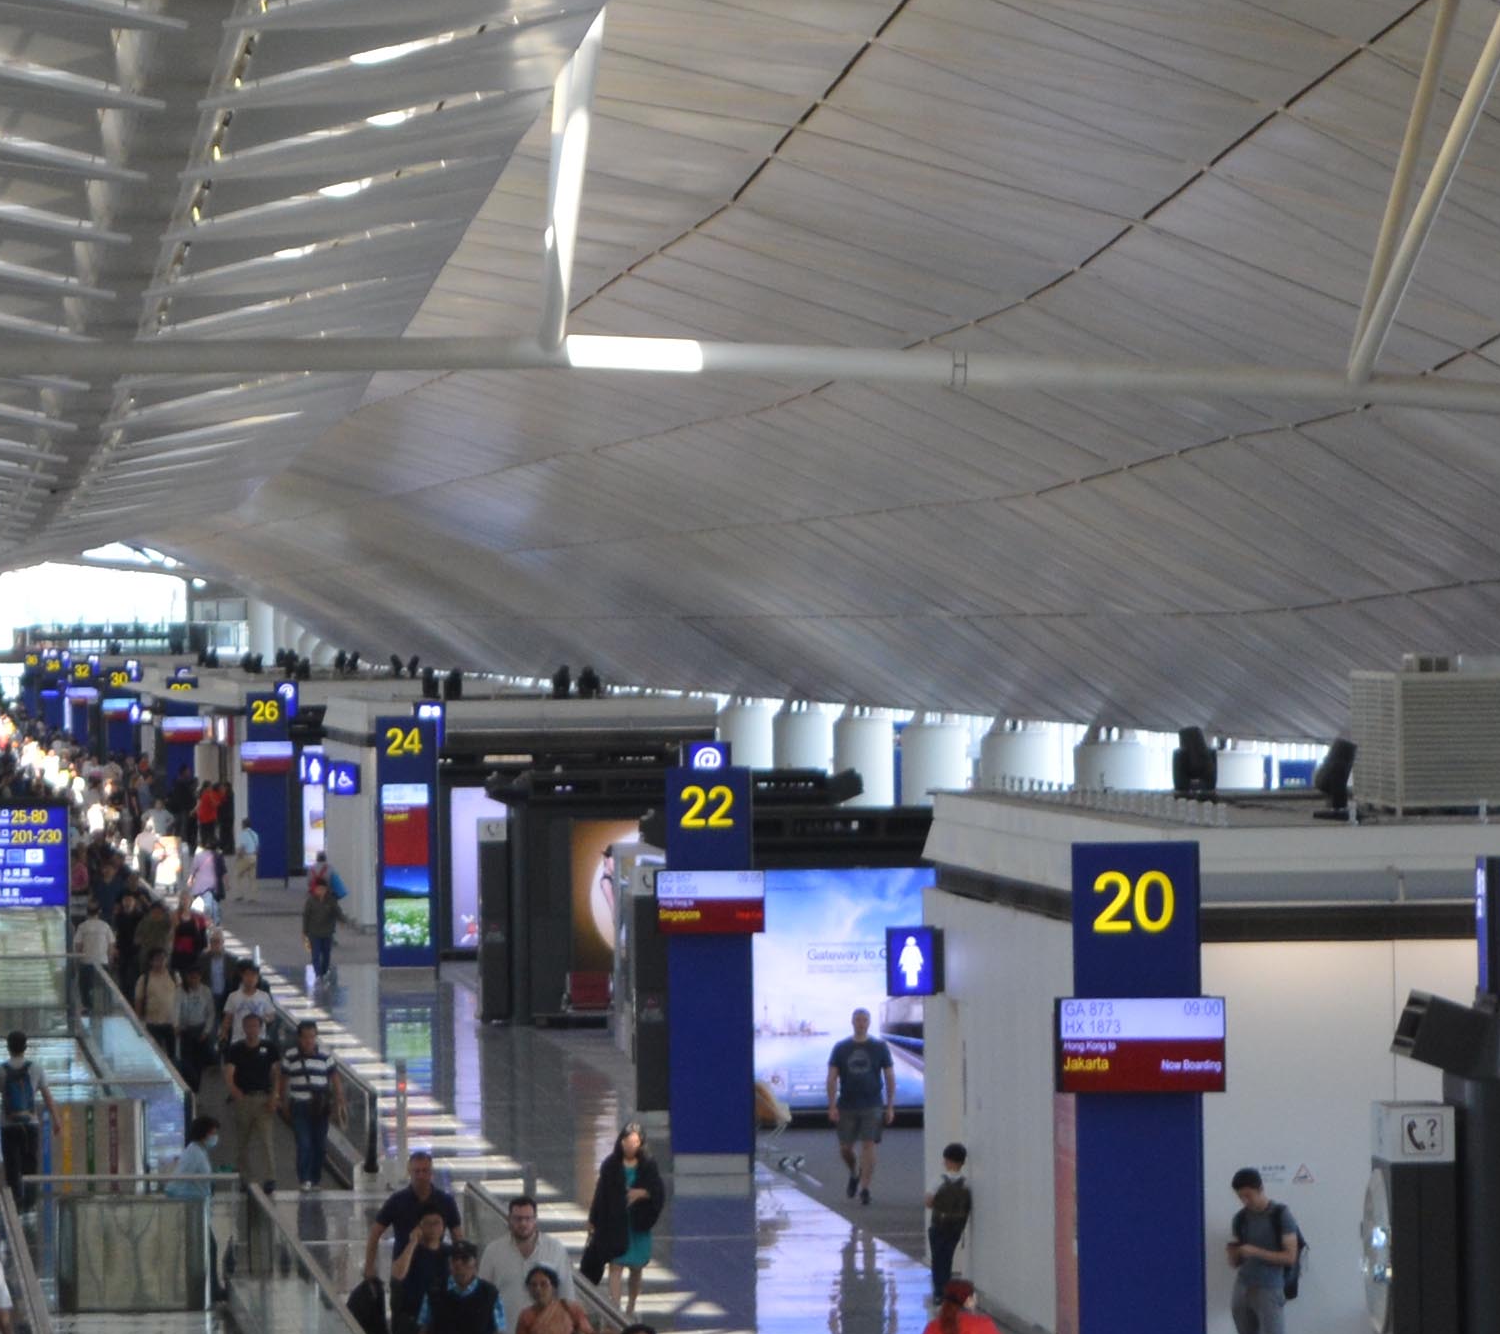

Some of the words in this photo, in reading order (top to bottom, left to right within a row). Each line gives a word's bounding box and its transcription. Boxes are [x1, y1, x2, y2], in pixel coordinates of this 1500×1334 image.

[75, 664, 90, 678] 32
[111, 672, 128, 687] 30
[252, 700, 279, 722] 26
[386, 727, 422, 755] 24
[680, 785, 734, 828] 22
[11, 809, 48, 825] 25-80
[11, 829, 62, 844] 201-230
[1093, 870, 1175, 933] 20
[1064, 1002, 1086, 1017] GA
[1090, 1001, 1114, 1016] 873
[1184, 1000, 1221, 1016] 09:00
[1065, 1019, 1085, 1033] HX
[1090, 1019, 1121, 1034] 1873
[1064, 1041, 1085, 1053] Hong
[1086, 1041, 1107, 1053] Kong
[1064, 1056, 1109, 1071] Jakarta
[1161, 1059, 1182, 1070] Now
[1183, 1059, 1222, 1073] Boarding
